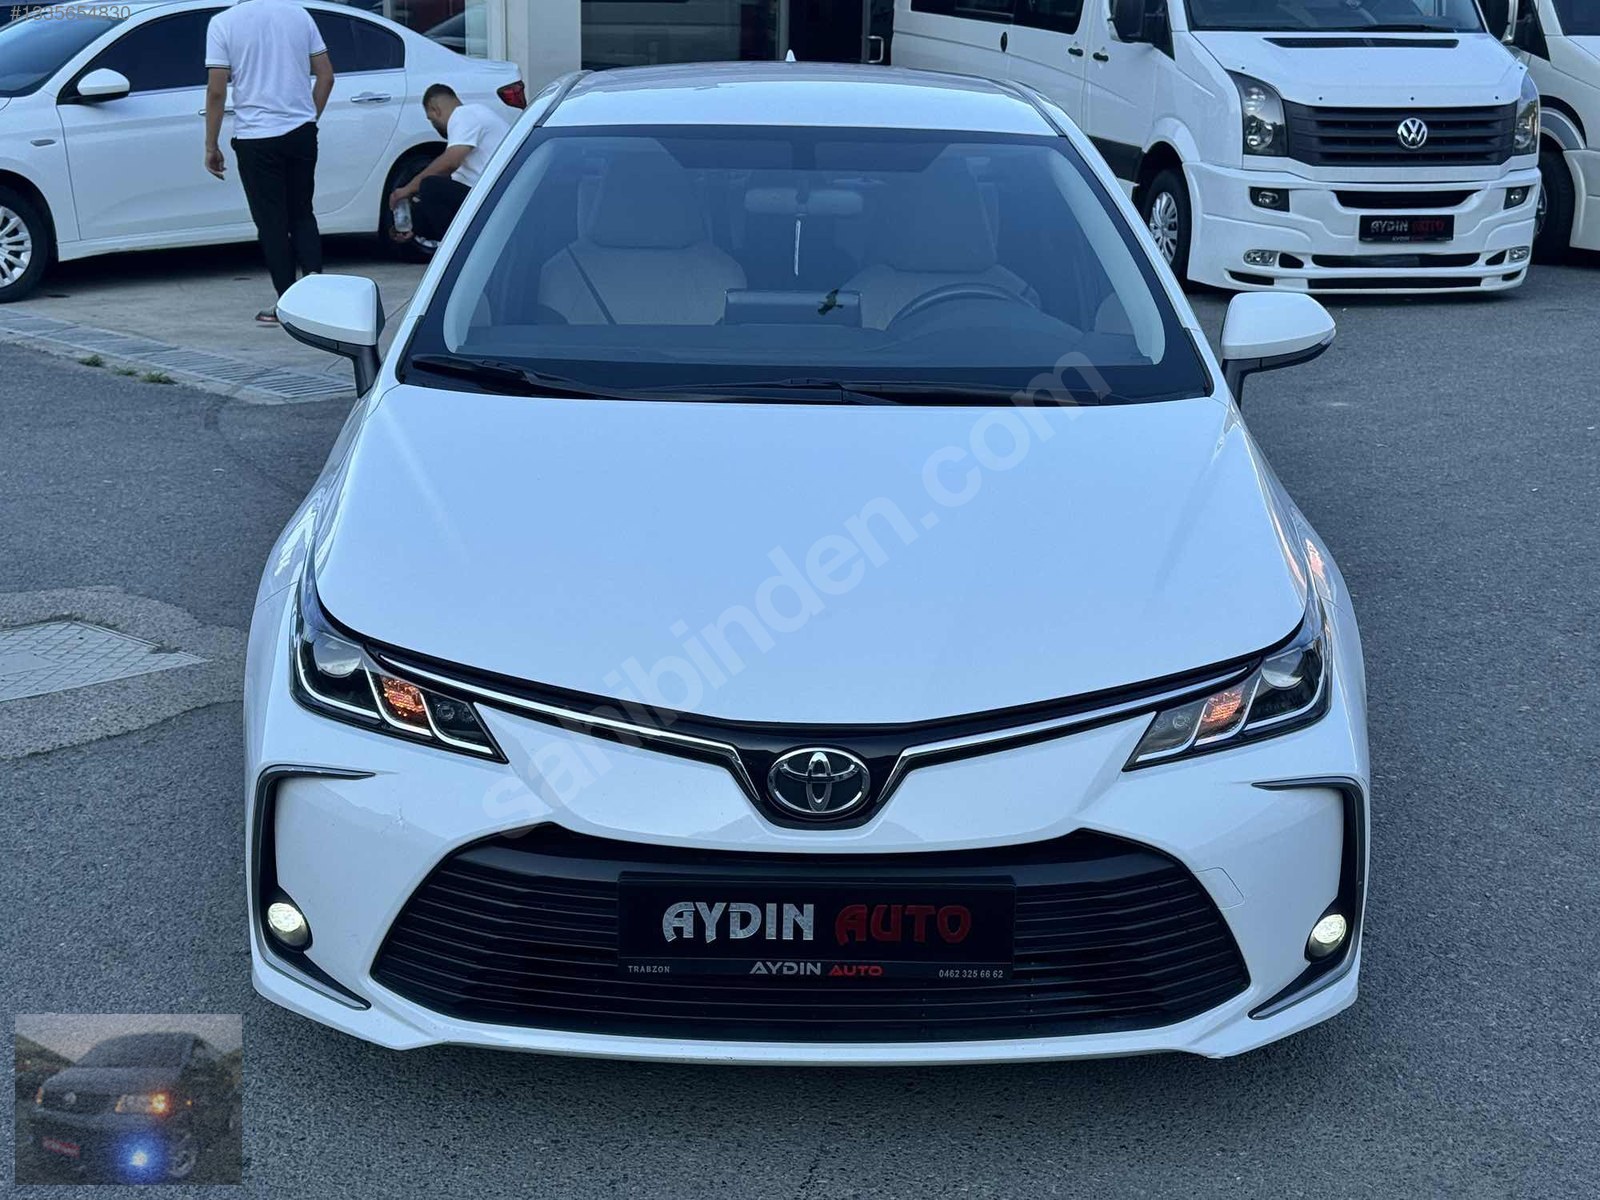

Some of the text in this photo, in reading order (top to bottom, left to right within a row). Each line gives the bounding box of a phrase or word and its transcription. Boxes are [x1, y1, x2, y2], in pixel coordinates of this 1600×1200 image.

[1370, 220, 1409, 233] AYDIN
[662, 901, 972, 946] AYDIN AUTO
[627, 965, 671, 974] TRABZON
[749, 961, 883, 976] AYDIN AUTO
[939, 969, 960, 978] 0462
[961, 969, 978, 978] 325
[992, 969, 1004, 978] 62
